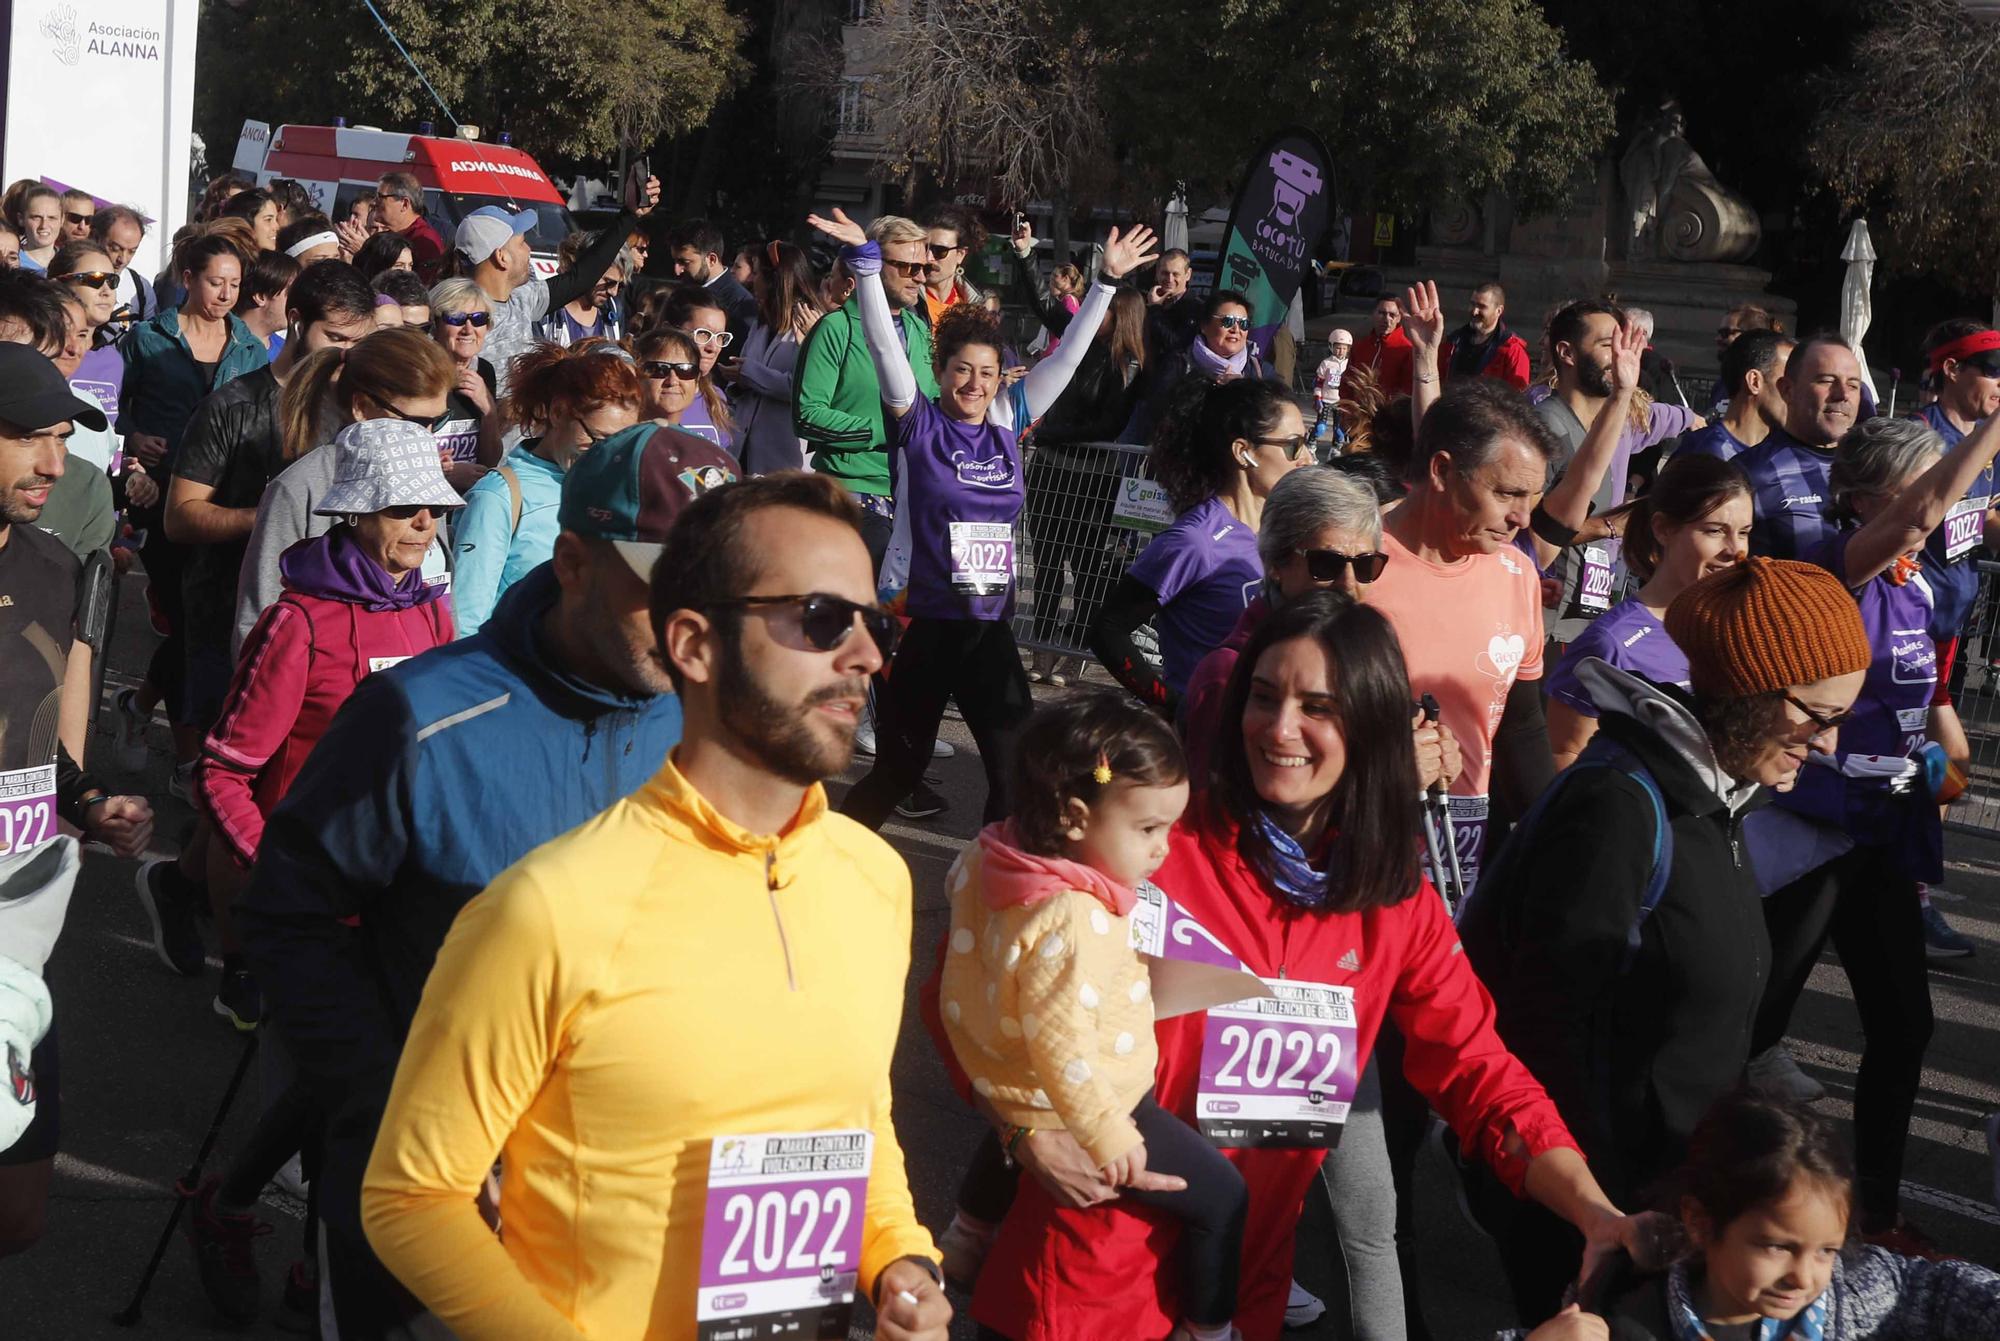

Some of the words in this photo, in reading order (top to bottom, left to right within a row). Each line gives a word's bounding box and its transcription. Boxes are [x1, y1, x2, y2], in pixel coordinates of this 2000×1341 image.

[88, 21, 160, 41] Asociación
[87, 38, 159, 61] ALANNA
[1948, 511, 1980, 546] 2022
[958, 542, 1007, 571] 2022
[1584, 565, 1610, 596] 2022
[4, 772, 25, 786] MARXA
[25, 768, 44, 784] CONTRA
[1305, 1004, 1317, 1018] DE
[1214, 1024, 1342, 1095] 2022
[767, 1139, 780, 1155] VI
[780, 1138, 813, 1154] MARXA
[814, 1135, 851, 1153] CONTRA
[853, 1134, 865, 1151] LA
[813, 1155, 826, 1171] DE
[719, 1186, 852, 1276] 2022
